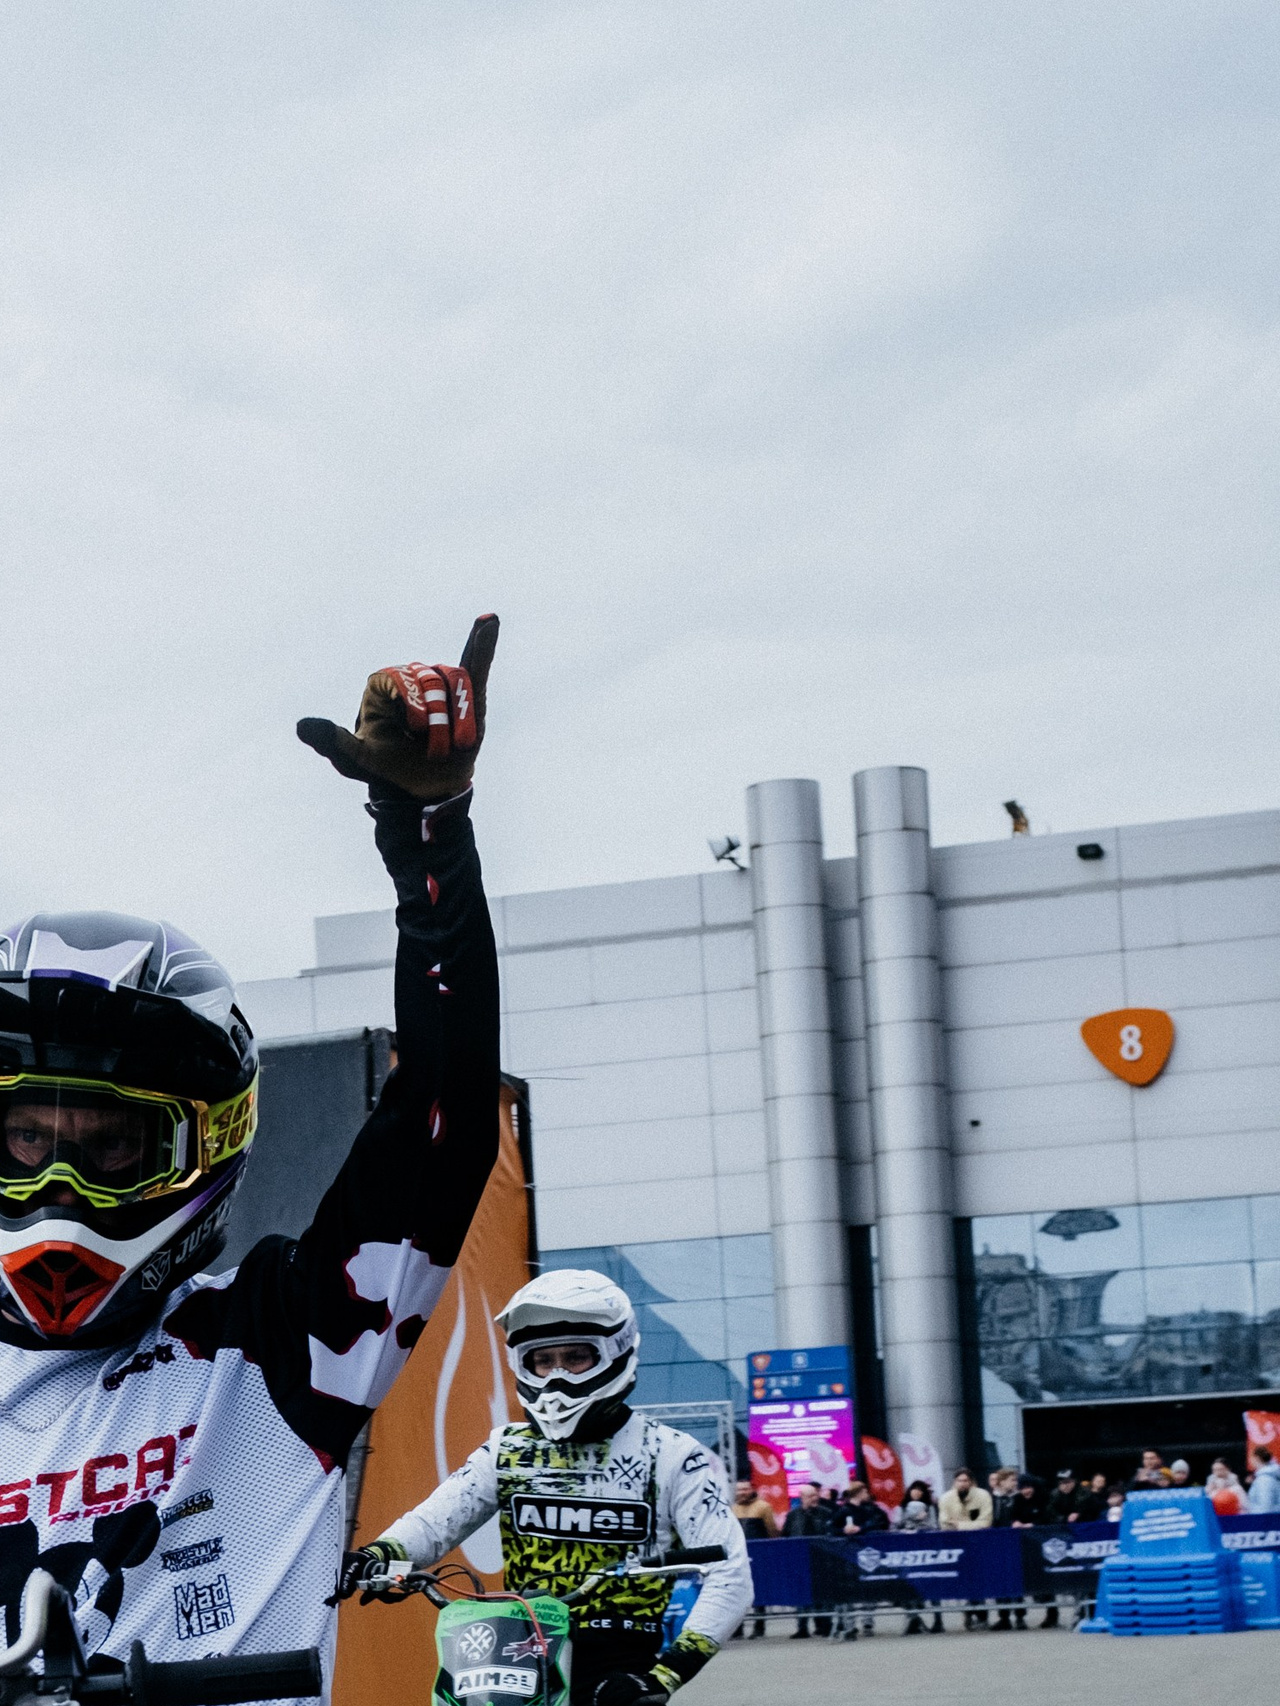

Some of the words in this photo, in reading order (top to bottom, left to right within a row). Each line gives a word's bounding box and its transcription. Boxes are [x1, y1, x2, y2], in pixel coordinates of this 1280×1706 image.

[1119, 1024, 1143, 1062] 8
[518, 1504, 644, 1535] AIMOL
[457, 1672, 534, 1692] AIMOL
